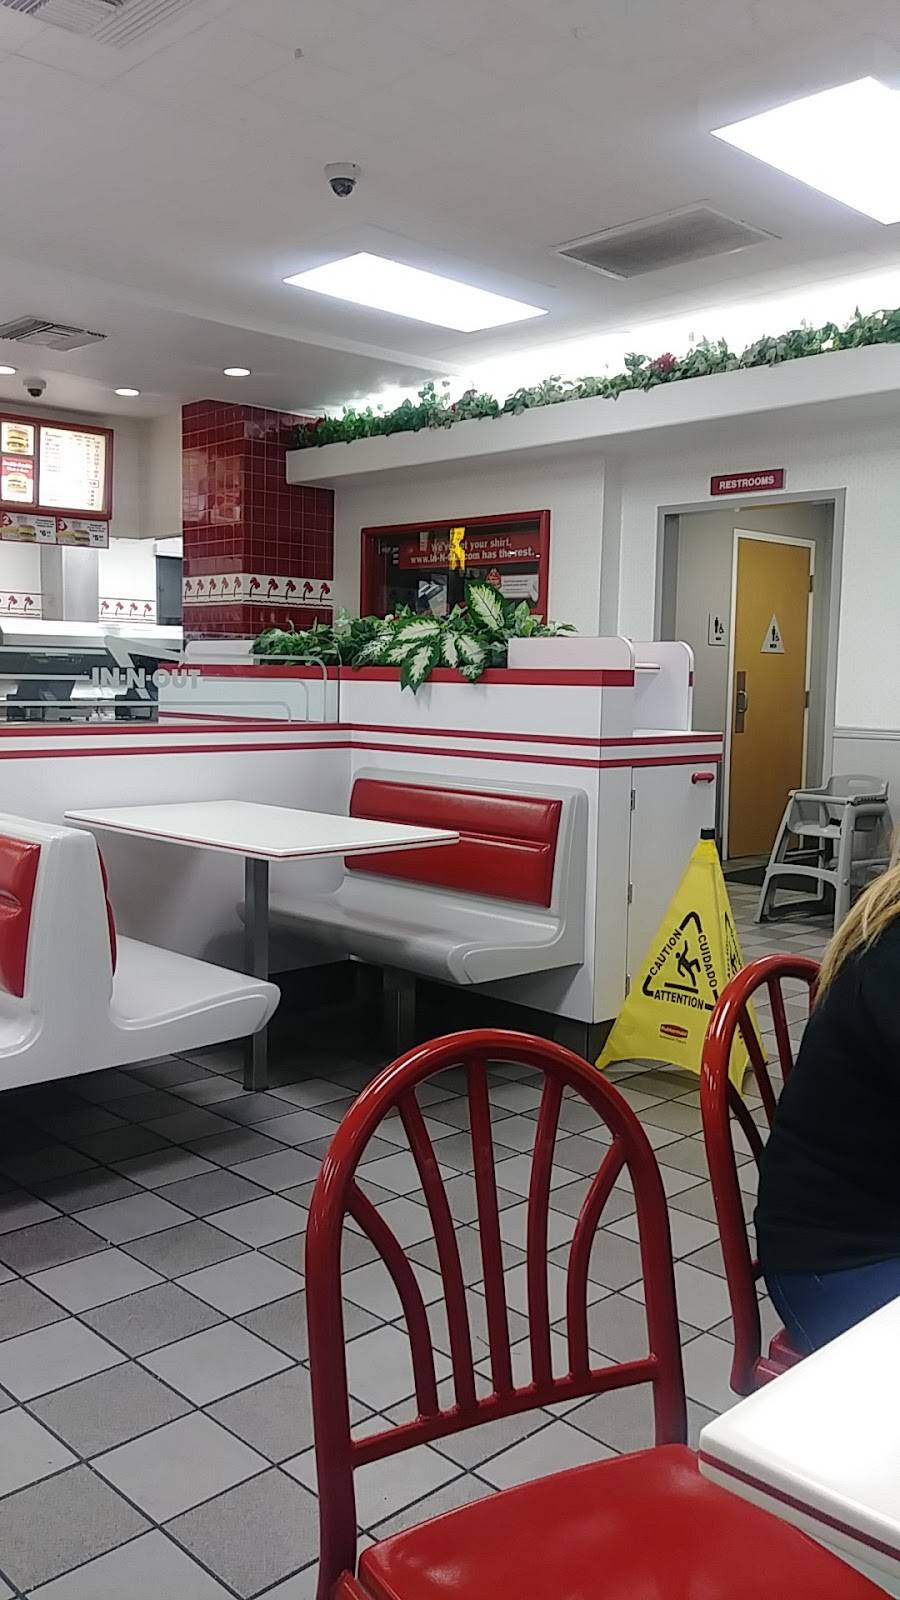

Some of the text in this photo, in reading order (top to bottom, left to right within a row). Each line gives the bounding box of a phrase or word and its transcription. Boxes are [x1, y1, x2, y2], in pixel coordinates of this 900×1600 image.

[719, 475, 775, 490] RESTROOMS
[470, 541, 488, 551] your
[482, 550, 497, 559] has
[499, 548, 511, 558] the
[92, 667, 201, 689] IN-N-OUT
[649, 928, 682, 976] CAUTION
[698, 934, 717, 988] CUIDADO
[654, 989, 705, 1010] ATTENTION
